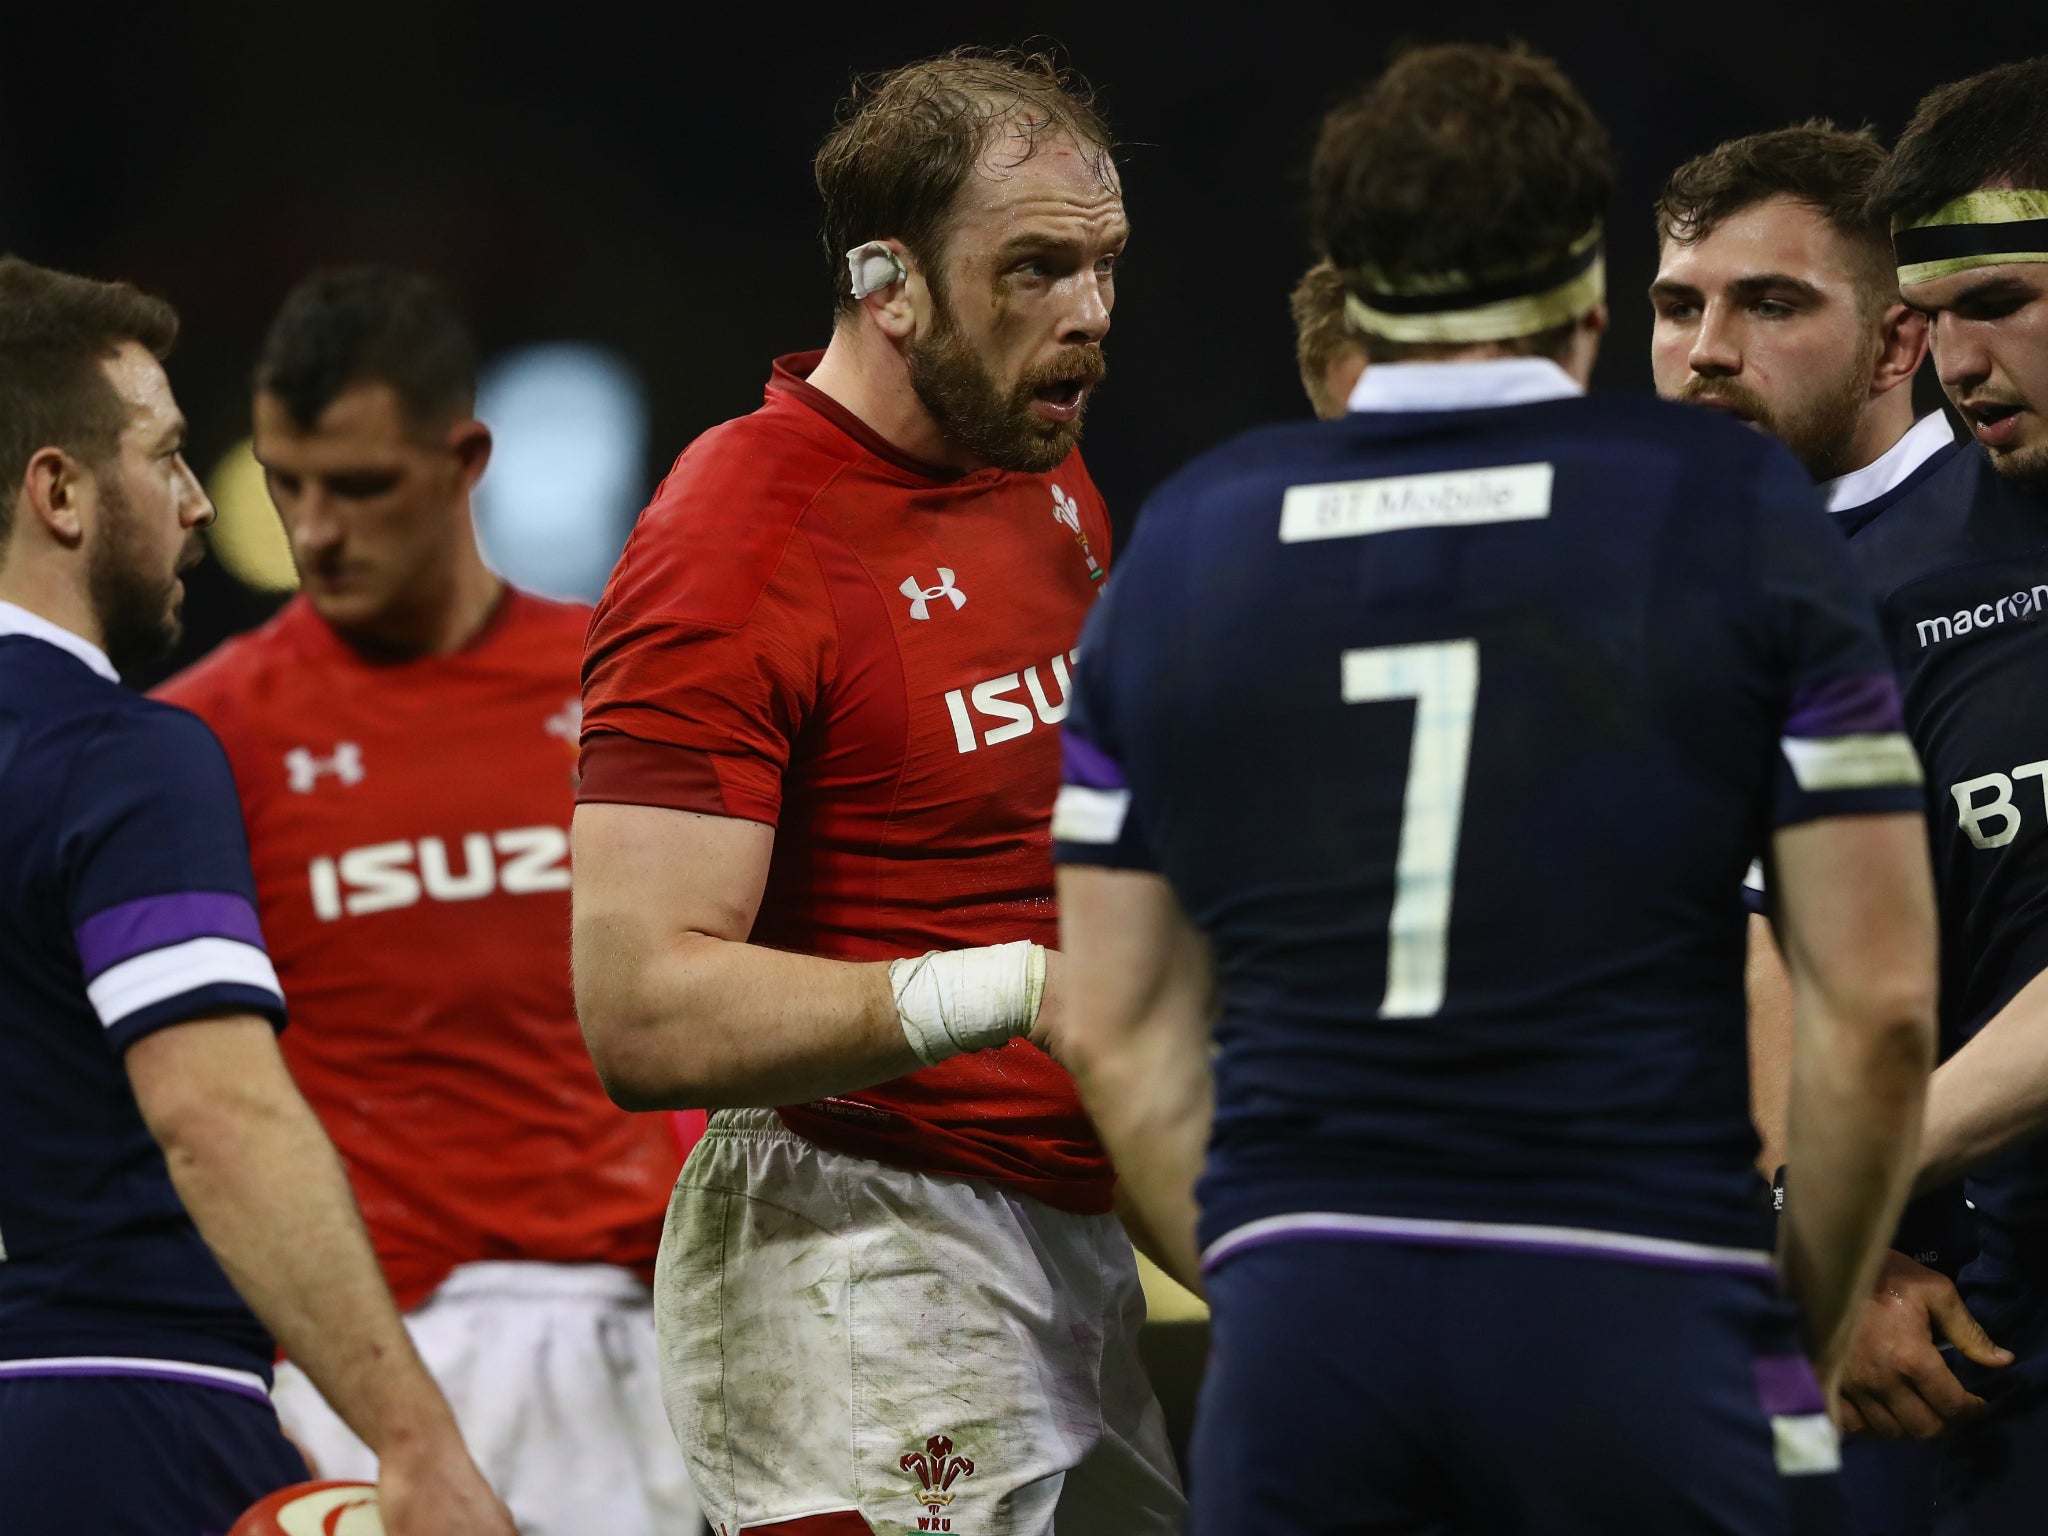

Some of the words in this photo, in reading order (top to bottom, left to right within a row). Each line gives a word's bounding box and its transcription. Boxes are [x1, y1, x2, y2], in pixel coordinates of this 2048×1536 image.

[1916, 585, 2048, 647] macron
[945, 647, 1080, 754] ISU
[1340, 637, 1480, 1020] 7
[917, 1517, 951, 1532] WRU
